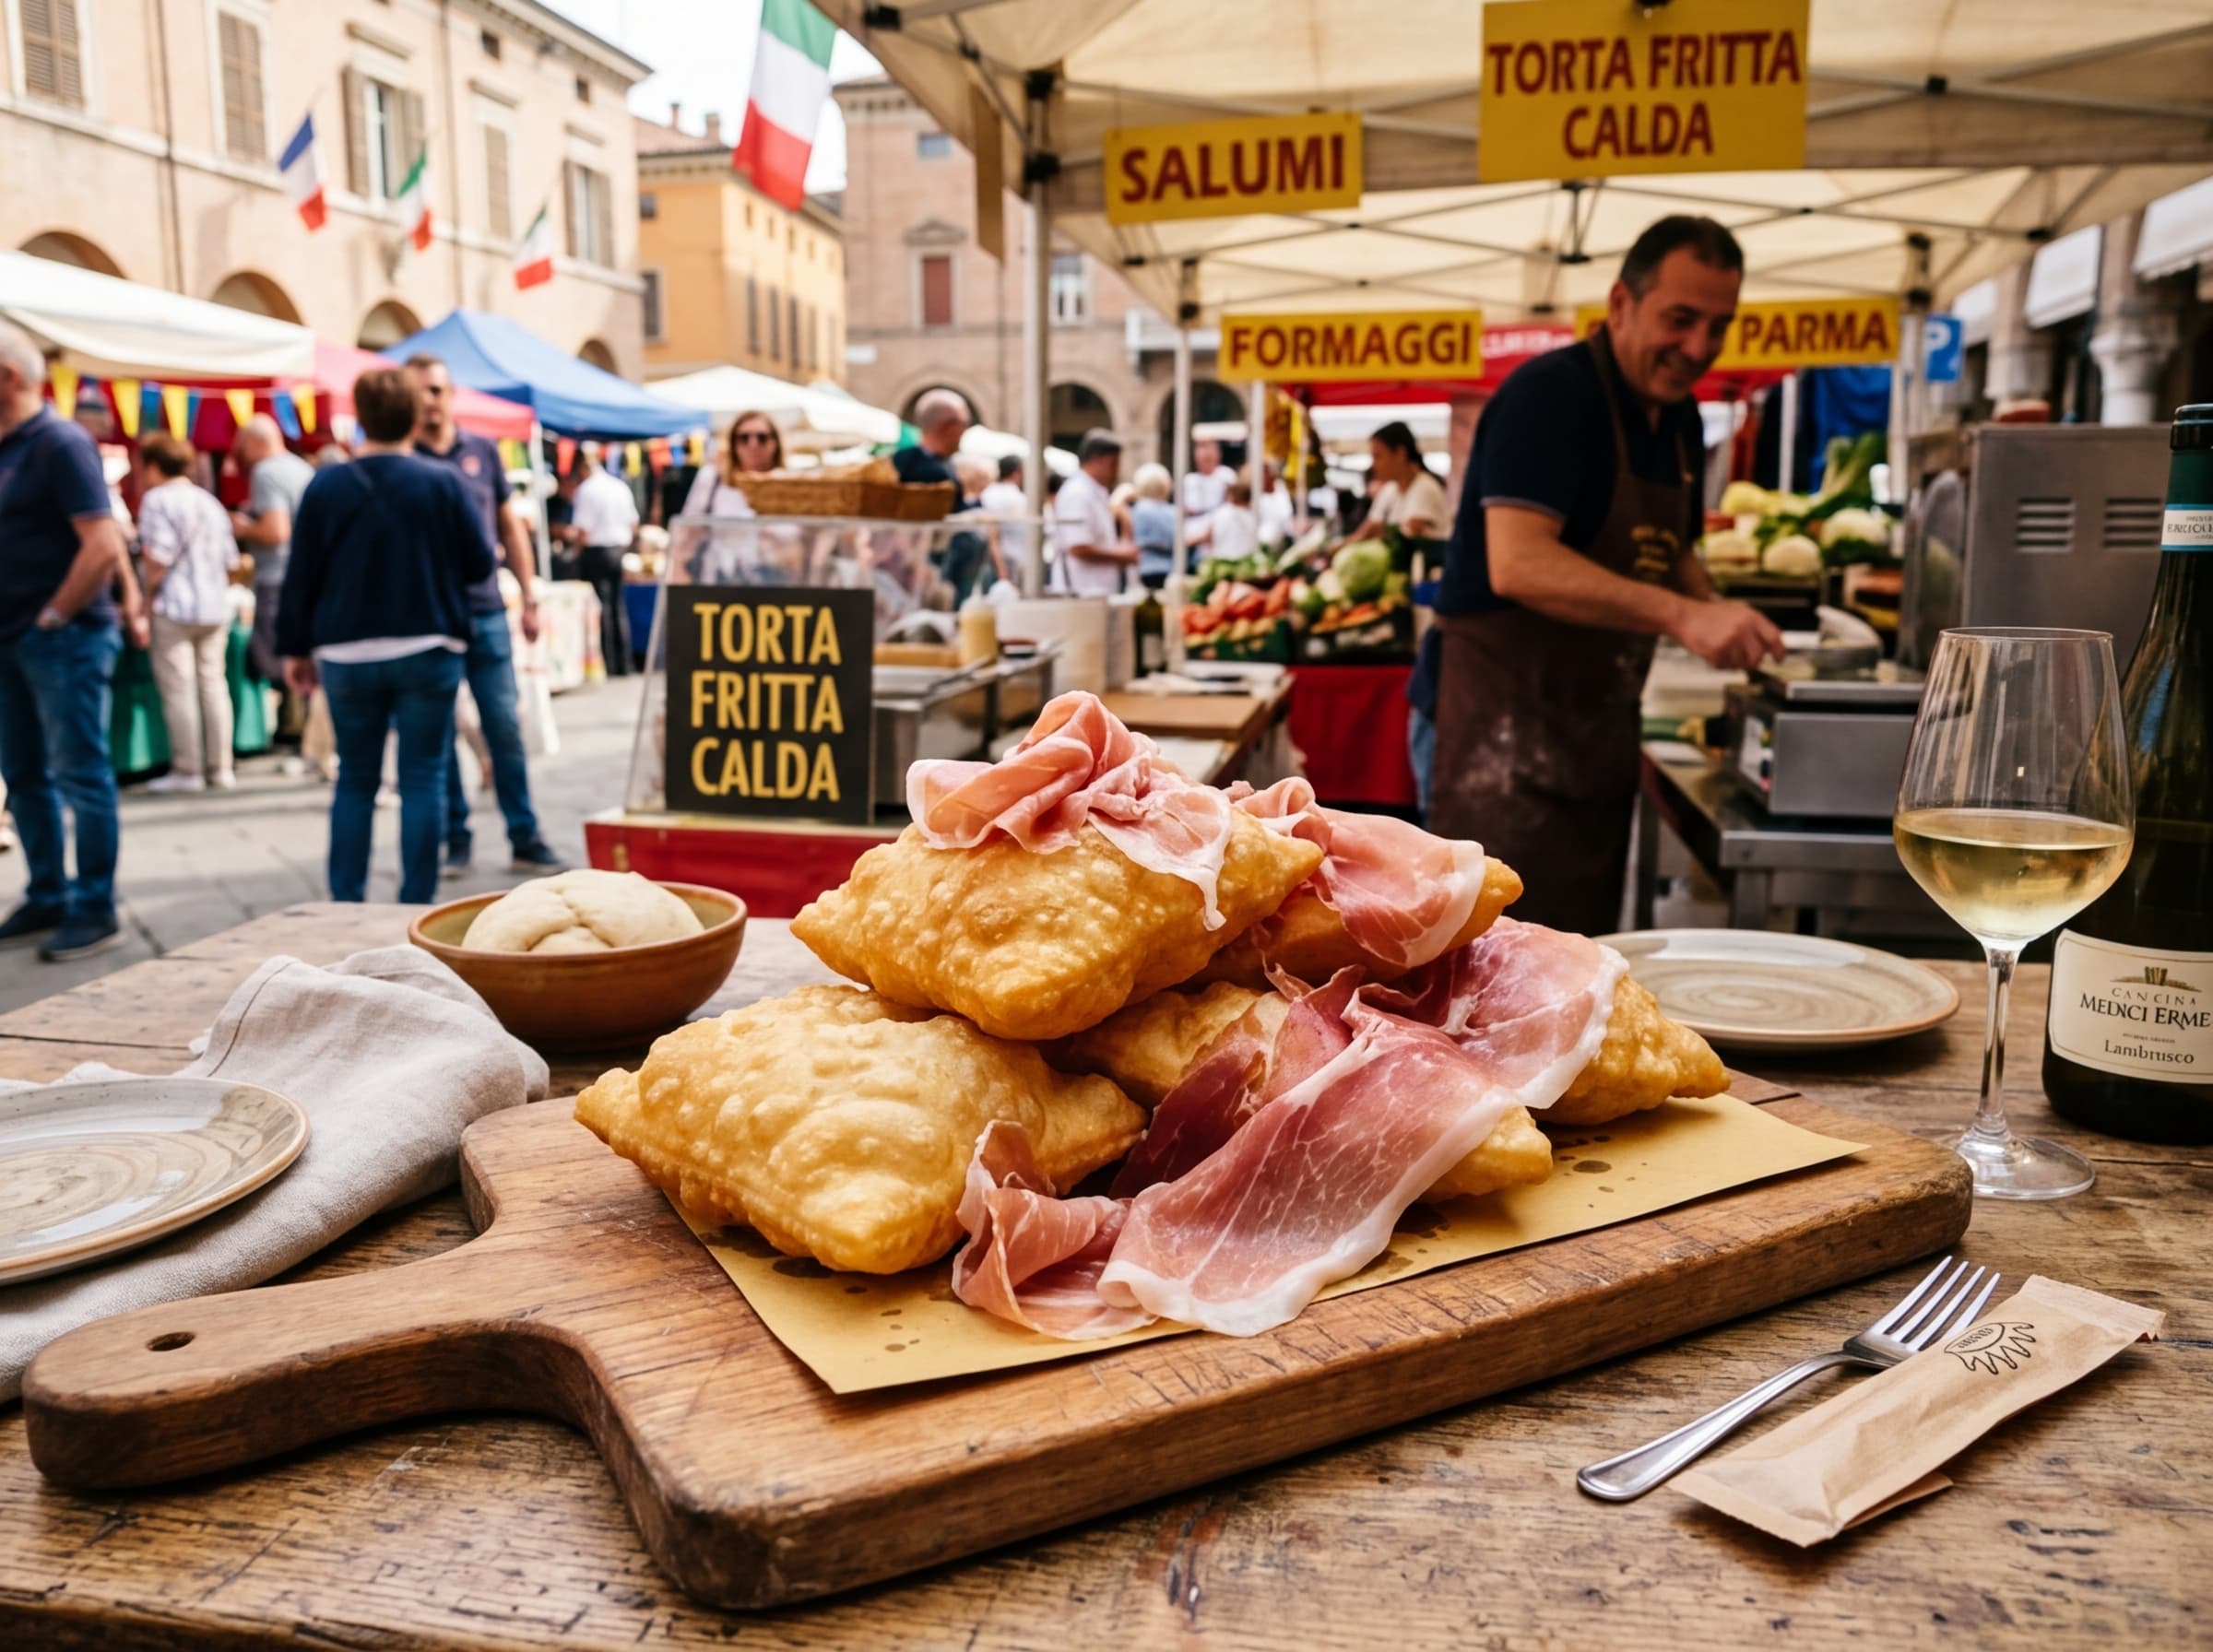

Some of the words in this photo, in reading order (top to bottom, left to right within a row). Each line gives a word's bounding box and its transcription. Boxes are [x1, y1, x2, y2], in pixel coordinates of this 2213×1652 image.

[1487, 37, 1636, 97] TORTA
[1648, 29, 1803, 88] FRITTA
[1562, 100, 1714, 160] CALDA
[1120, 133, 1345, 205] SALUMI
[1230, 322, 1472, 370] FORMAGGI
[1738, 311, 1889, 356] PARMA
[1923, 320, 1953, 371] P
[692, 602, 842, 666] TORTA
[692, 670, 844, 734] FRITTA
[692, 737, 841, 802] CALDA
[2103, 1039, 2195, 1065] Lambrusco
